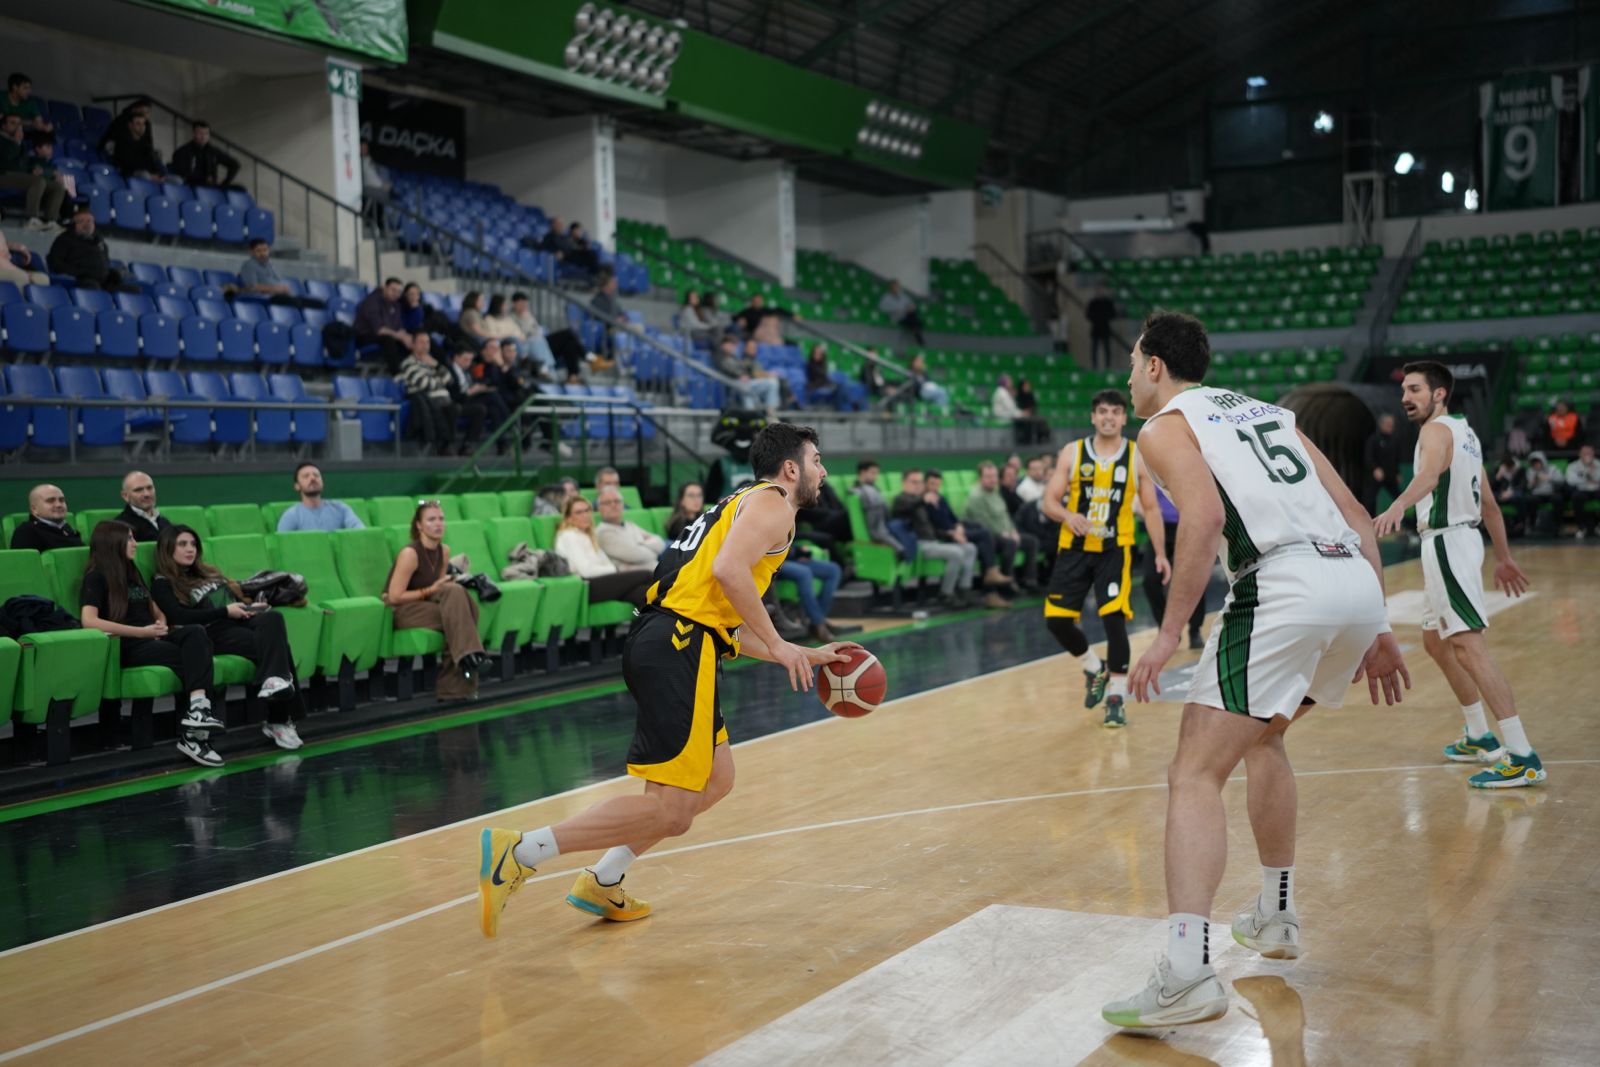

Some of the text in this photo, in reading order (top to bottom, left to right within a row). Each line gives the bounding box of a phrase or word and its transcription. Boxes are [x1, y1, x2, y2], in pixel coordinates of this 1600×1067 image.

[379, 125, 457, 159] DAÇKA
[1503, 124, 1537, 181] 9
[1235, 420, 1308, 485] 15
[1084, 486, 1122, 503] KONYA
[1087, 501, 1111, 522] 20
